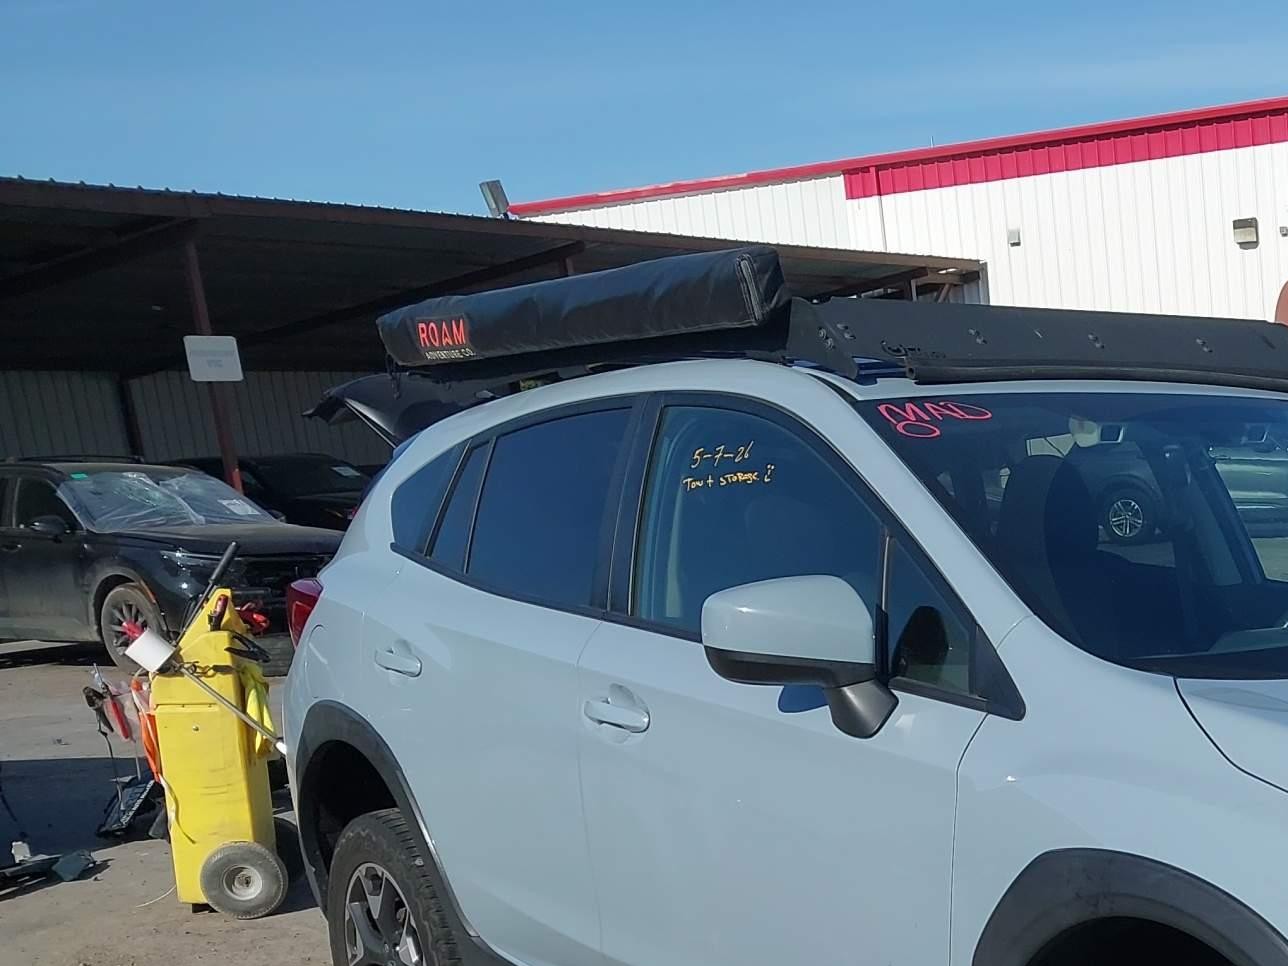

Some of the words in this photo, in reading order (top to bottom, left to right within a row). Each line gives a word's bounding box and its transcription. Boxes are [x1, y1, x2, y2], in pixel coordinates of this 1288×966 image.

[418, 319, 466, 347] ROAM
[425, 350, 463, 360] ADVENTURE
[691, 440, 754, 469] 5-7-26
